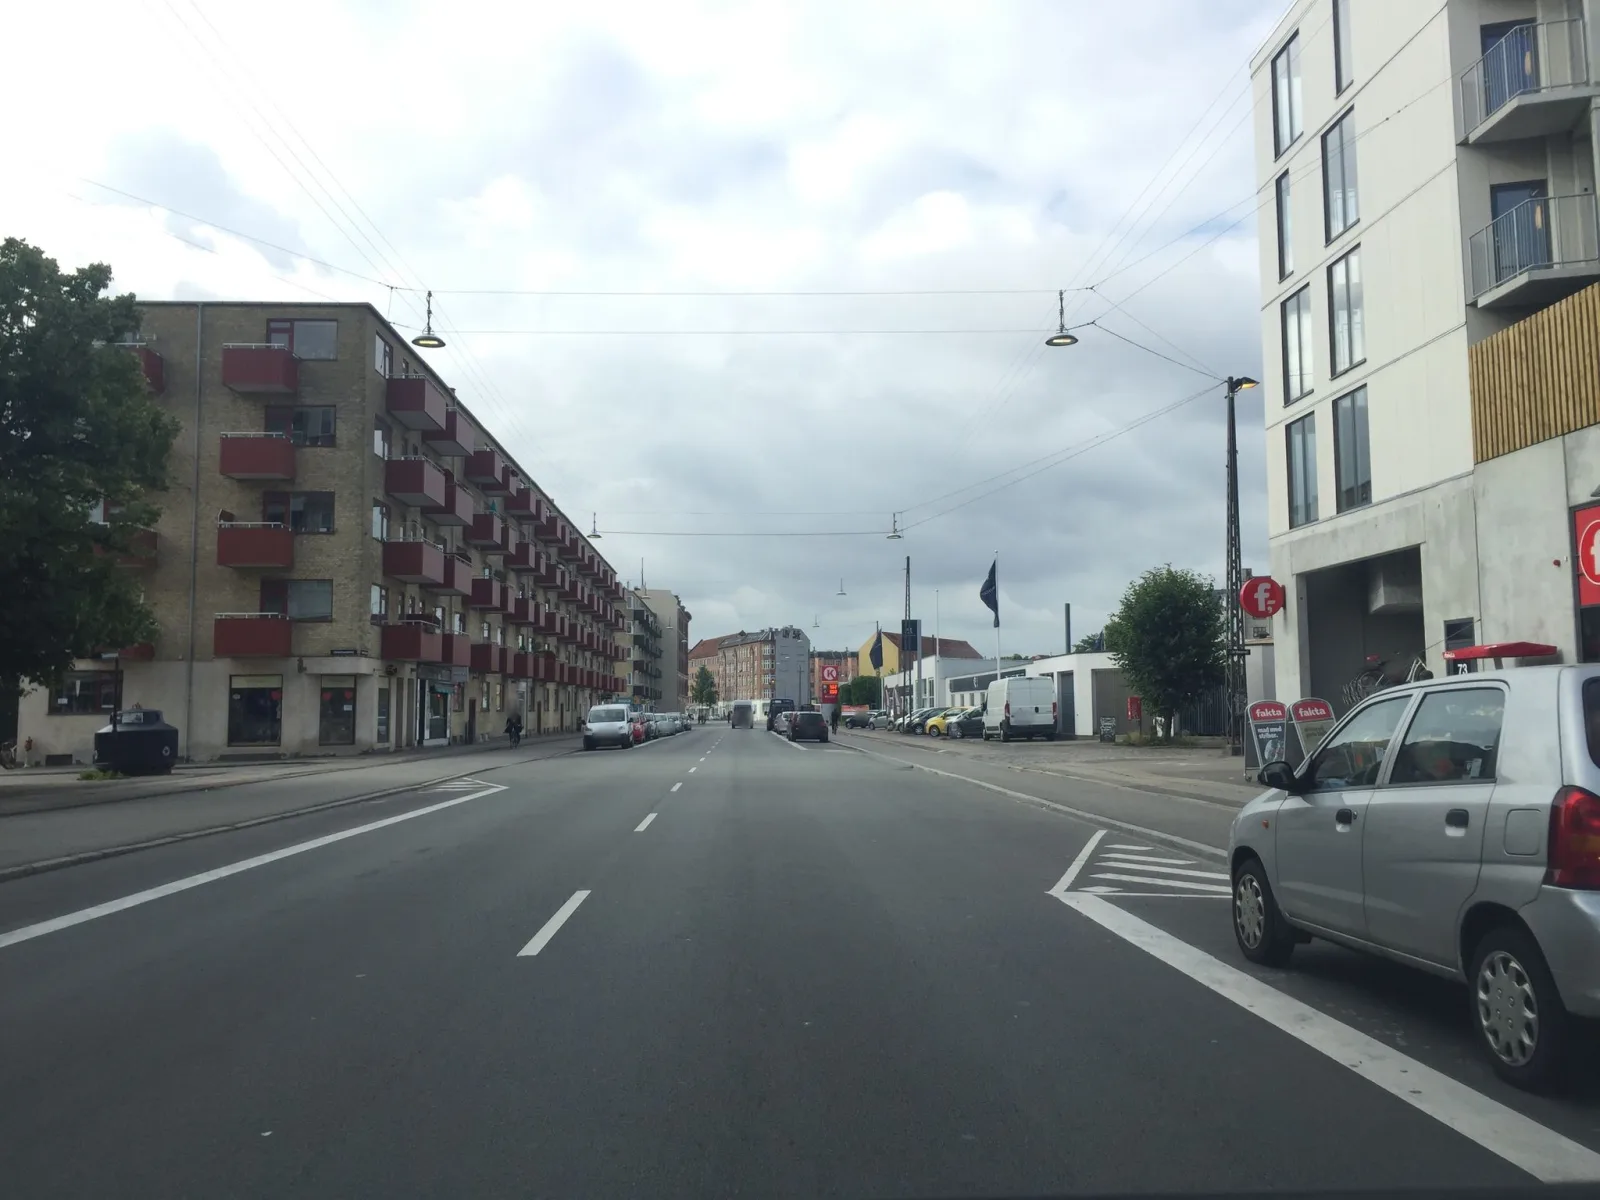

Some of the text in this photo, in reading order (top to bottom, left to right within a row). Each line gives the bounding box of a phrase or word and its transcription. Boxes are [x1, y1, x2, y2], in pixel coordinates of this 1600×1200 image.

[1457, 663, 1468, 675] 73
[1256, 708, 1282, 717] fakta
[1298, 707, 1326, 717] fakta
